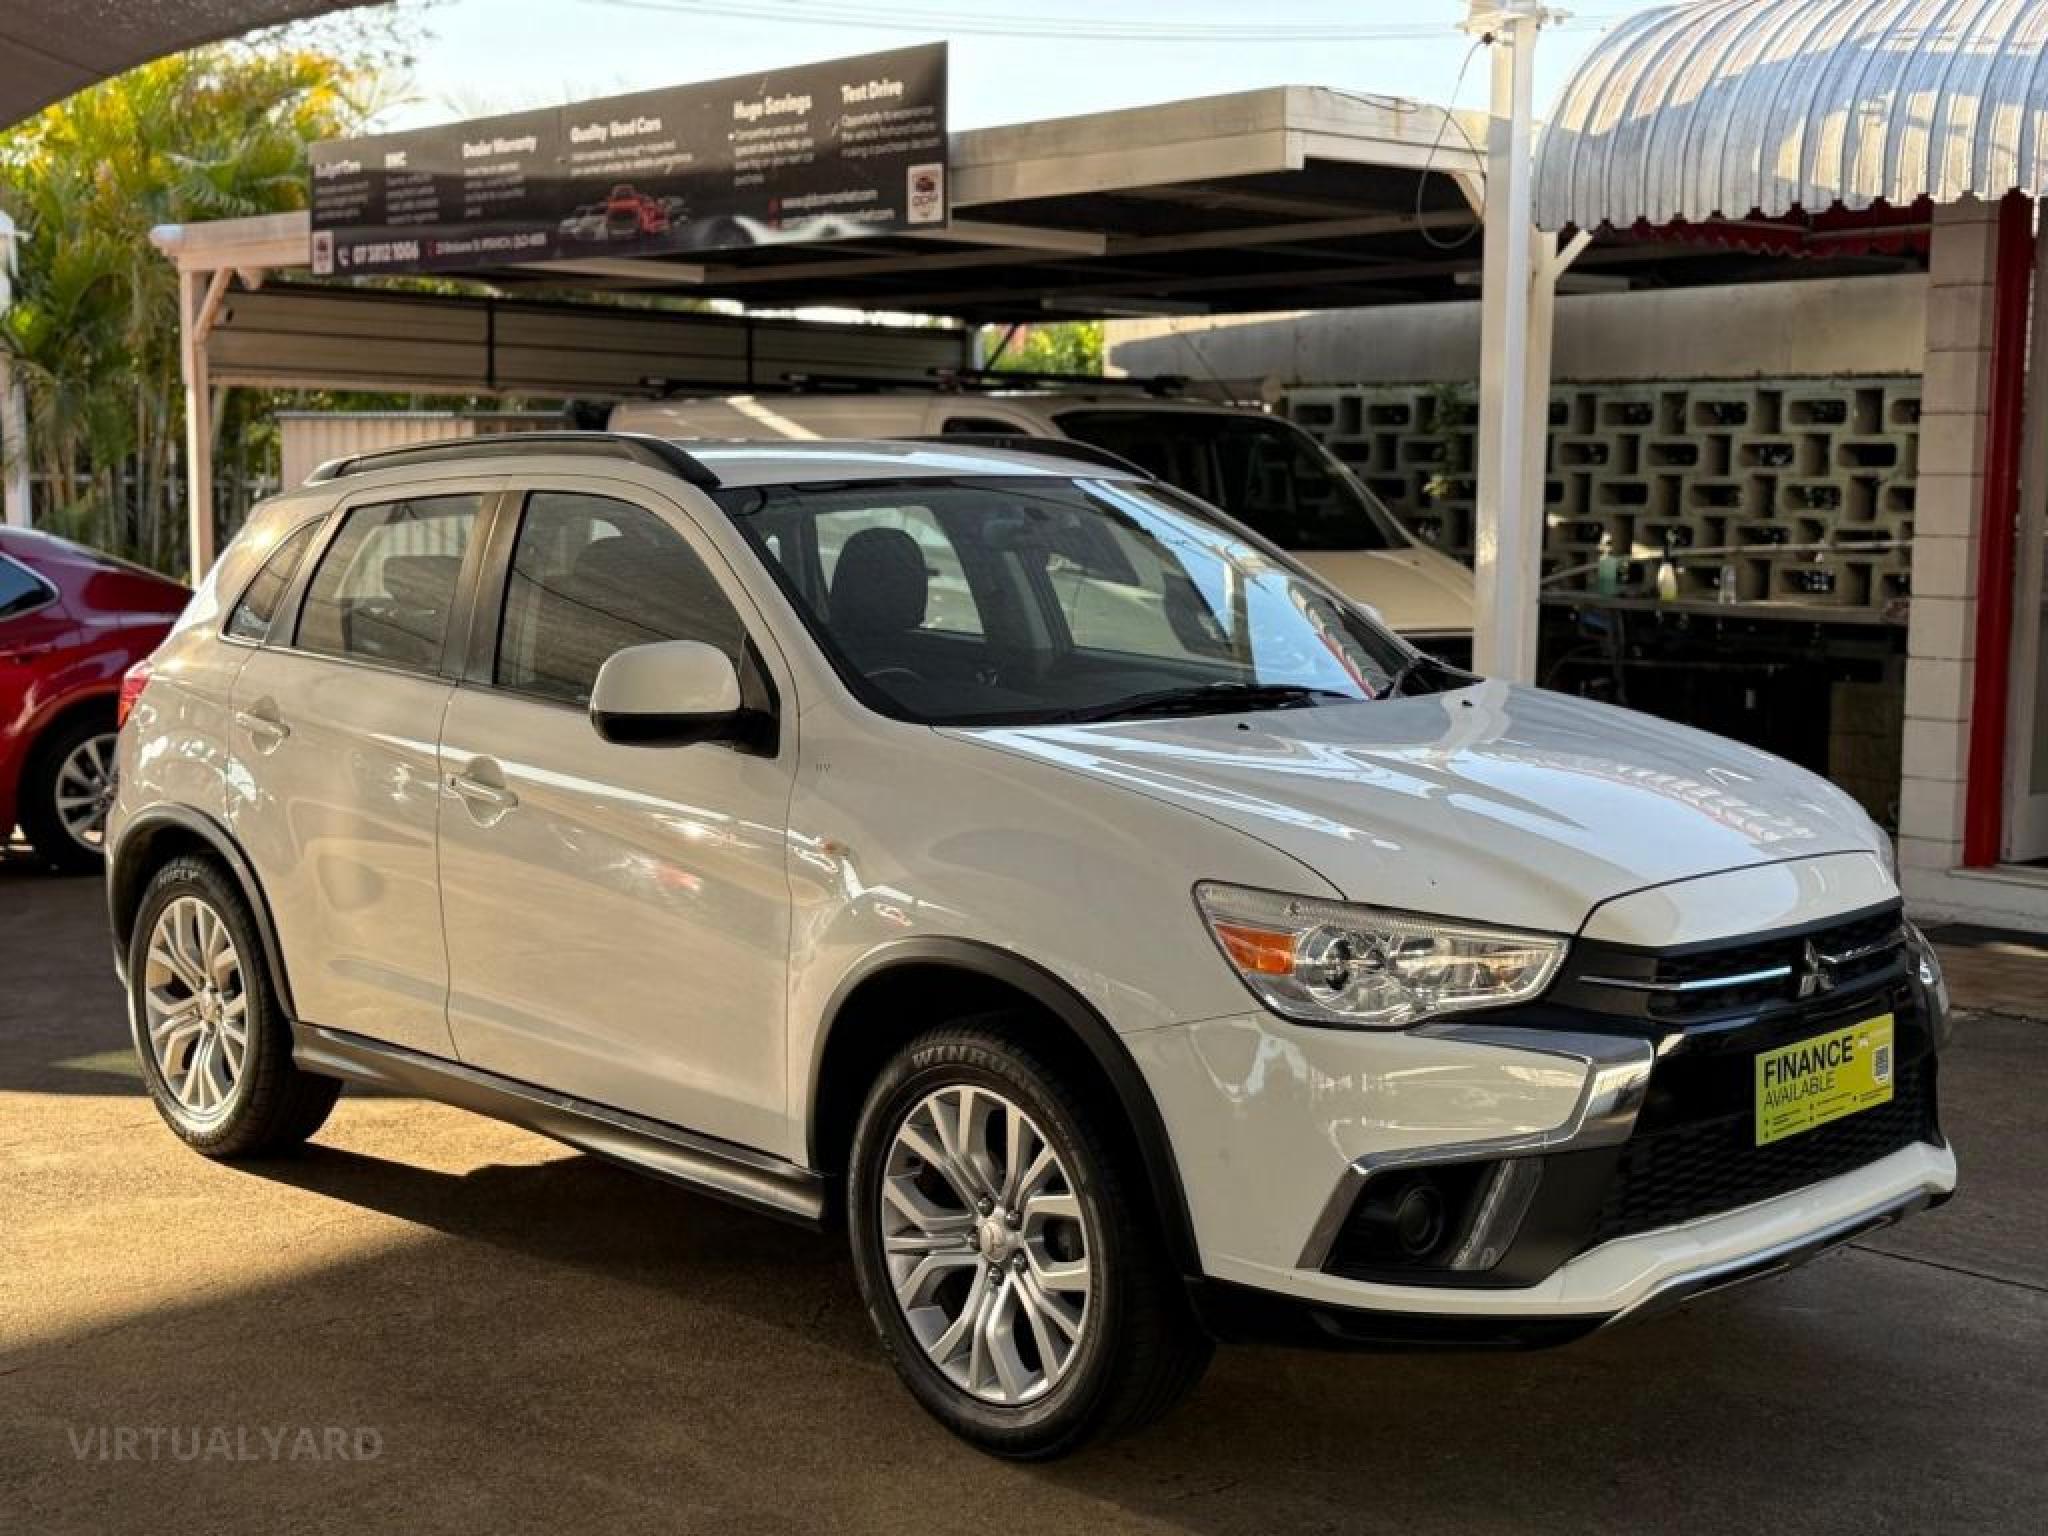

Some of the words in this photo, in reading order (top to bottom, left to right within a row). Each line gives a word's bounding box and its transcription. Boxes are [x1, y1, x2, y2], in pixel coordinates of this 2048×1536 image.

[841, 84, 867, 104] Test
[868, 78, 904, 99] Drive
[733, 100, 763, 122] Huge
[765, 93, 812, 115] Savings
[570, 124, 608, 144] Quality
[610, 118, 635, 137] Used
[637, 115, 662, 132] Cars
[1764, 1035, 1855, 1089] FINANCE
[1764, 1071, 1836, 1110] AVAILABLE
